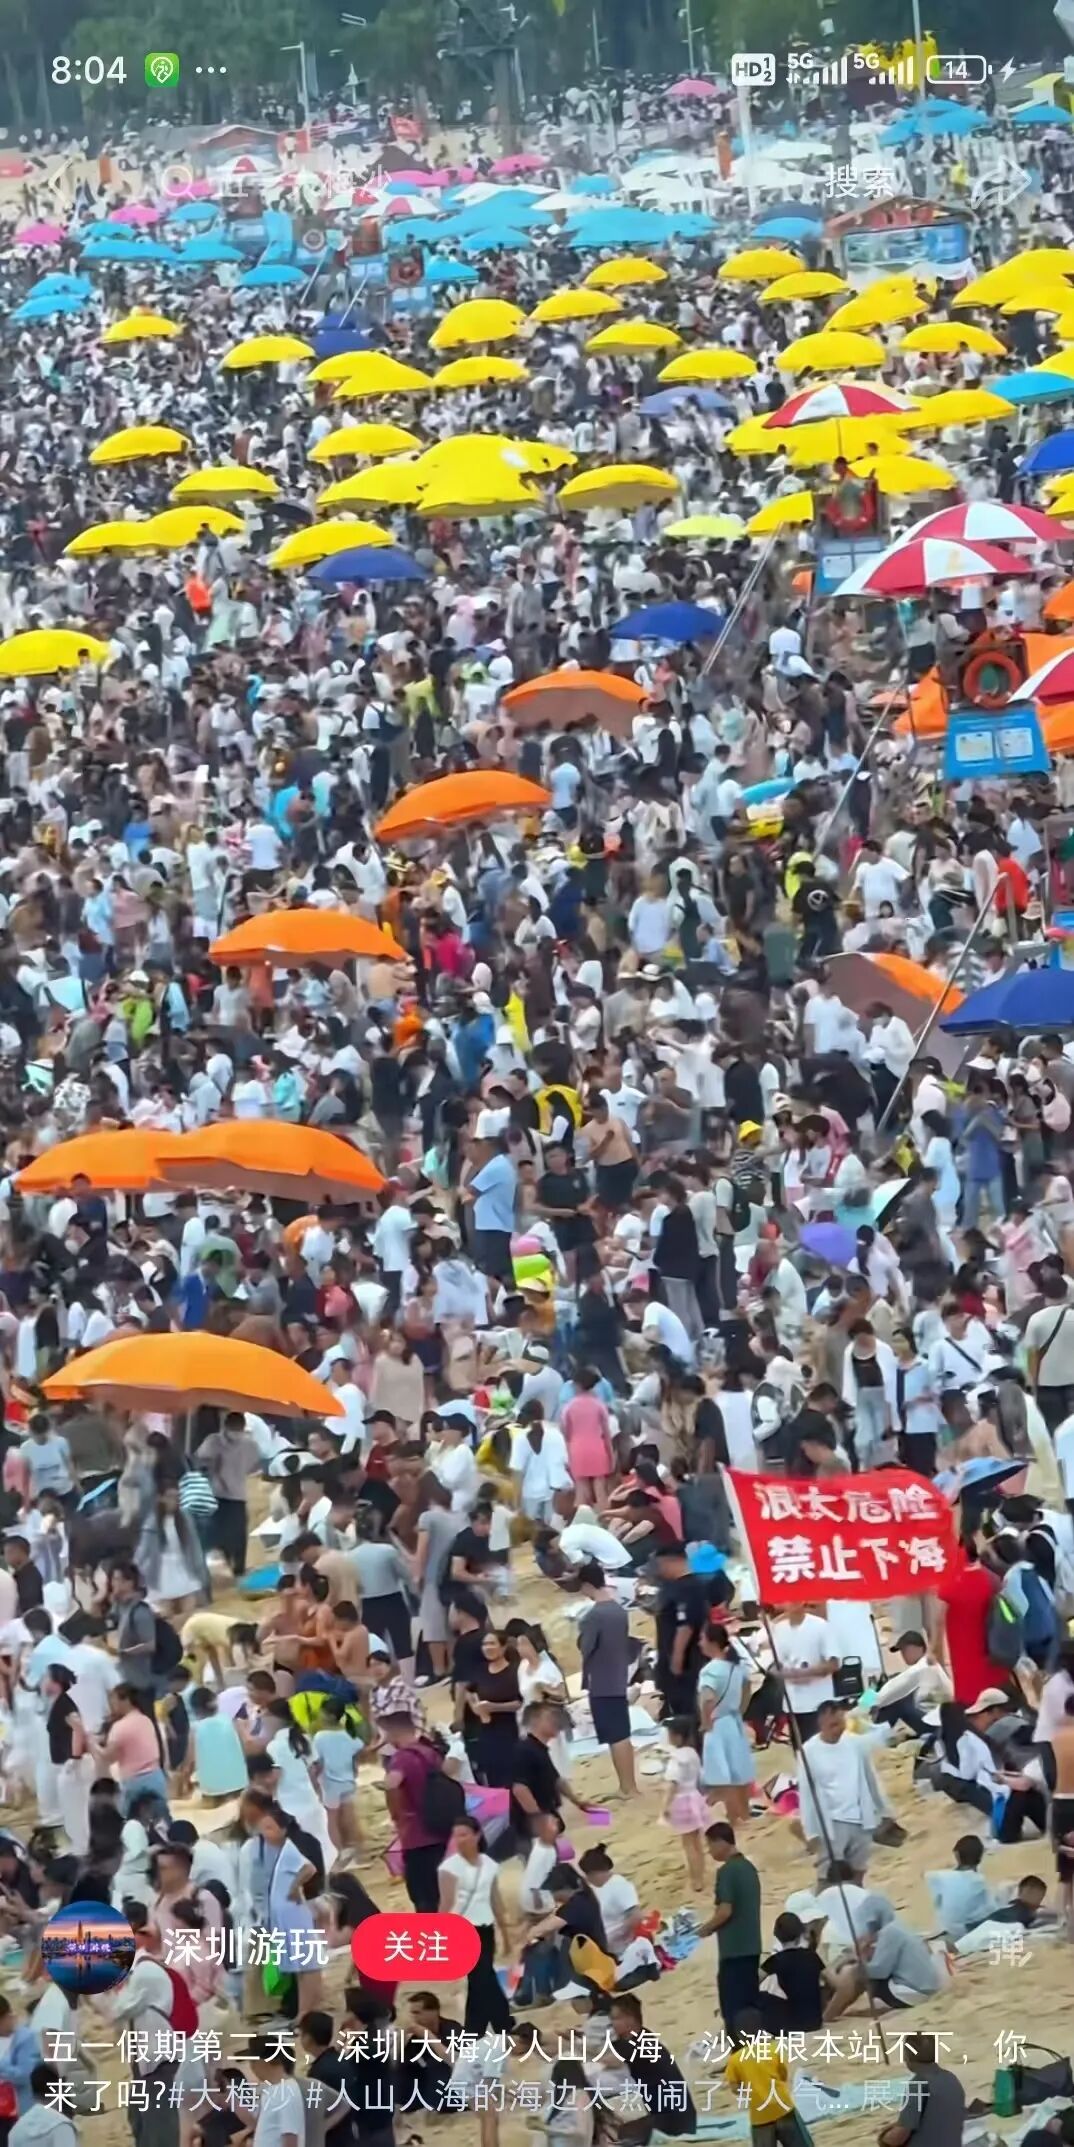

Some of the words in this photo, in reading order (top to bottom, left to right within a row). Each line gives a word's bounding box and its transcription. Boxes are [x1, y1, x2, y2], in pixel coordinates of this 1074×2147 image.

[753, 1482, 938, 1524] 浪太危险
[767, 1534, 948, 1584] 禁止下海
